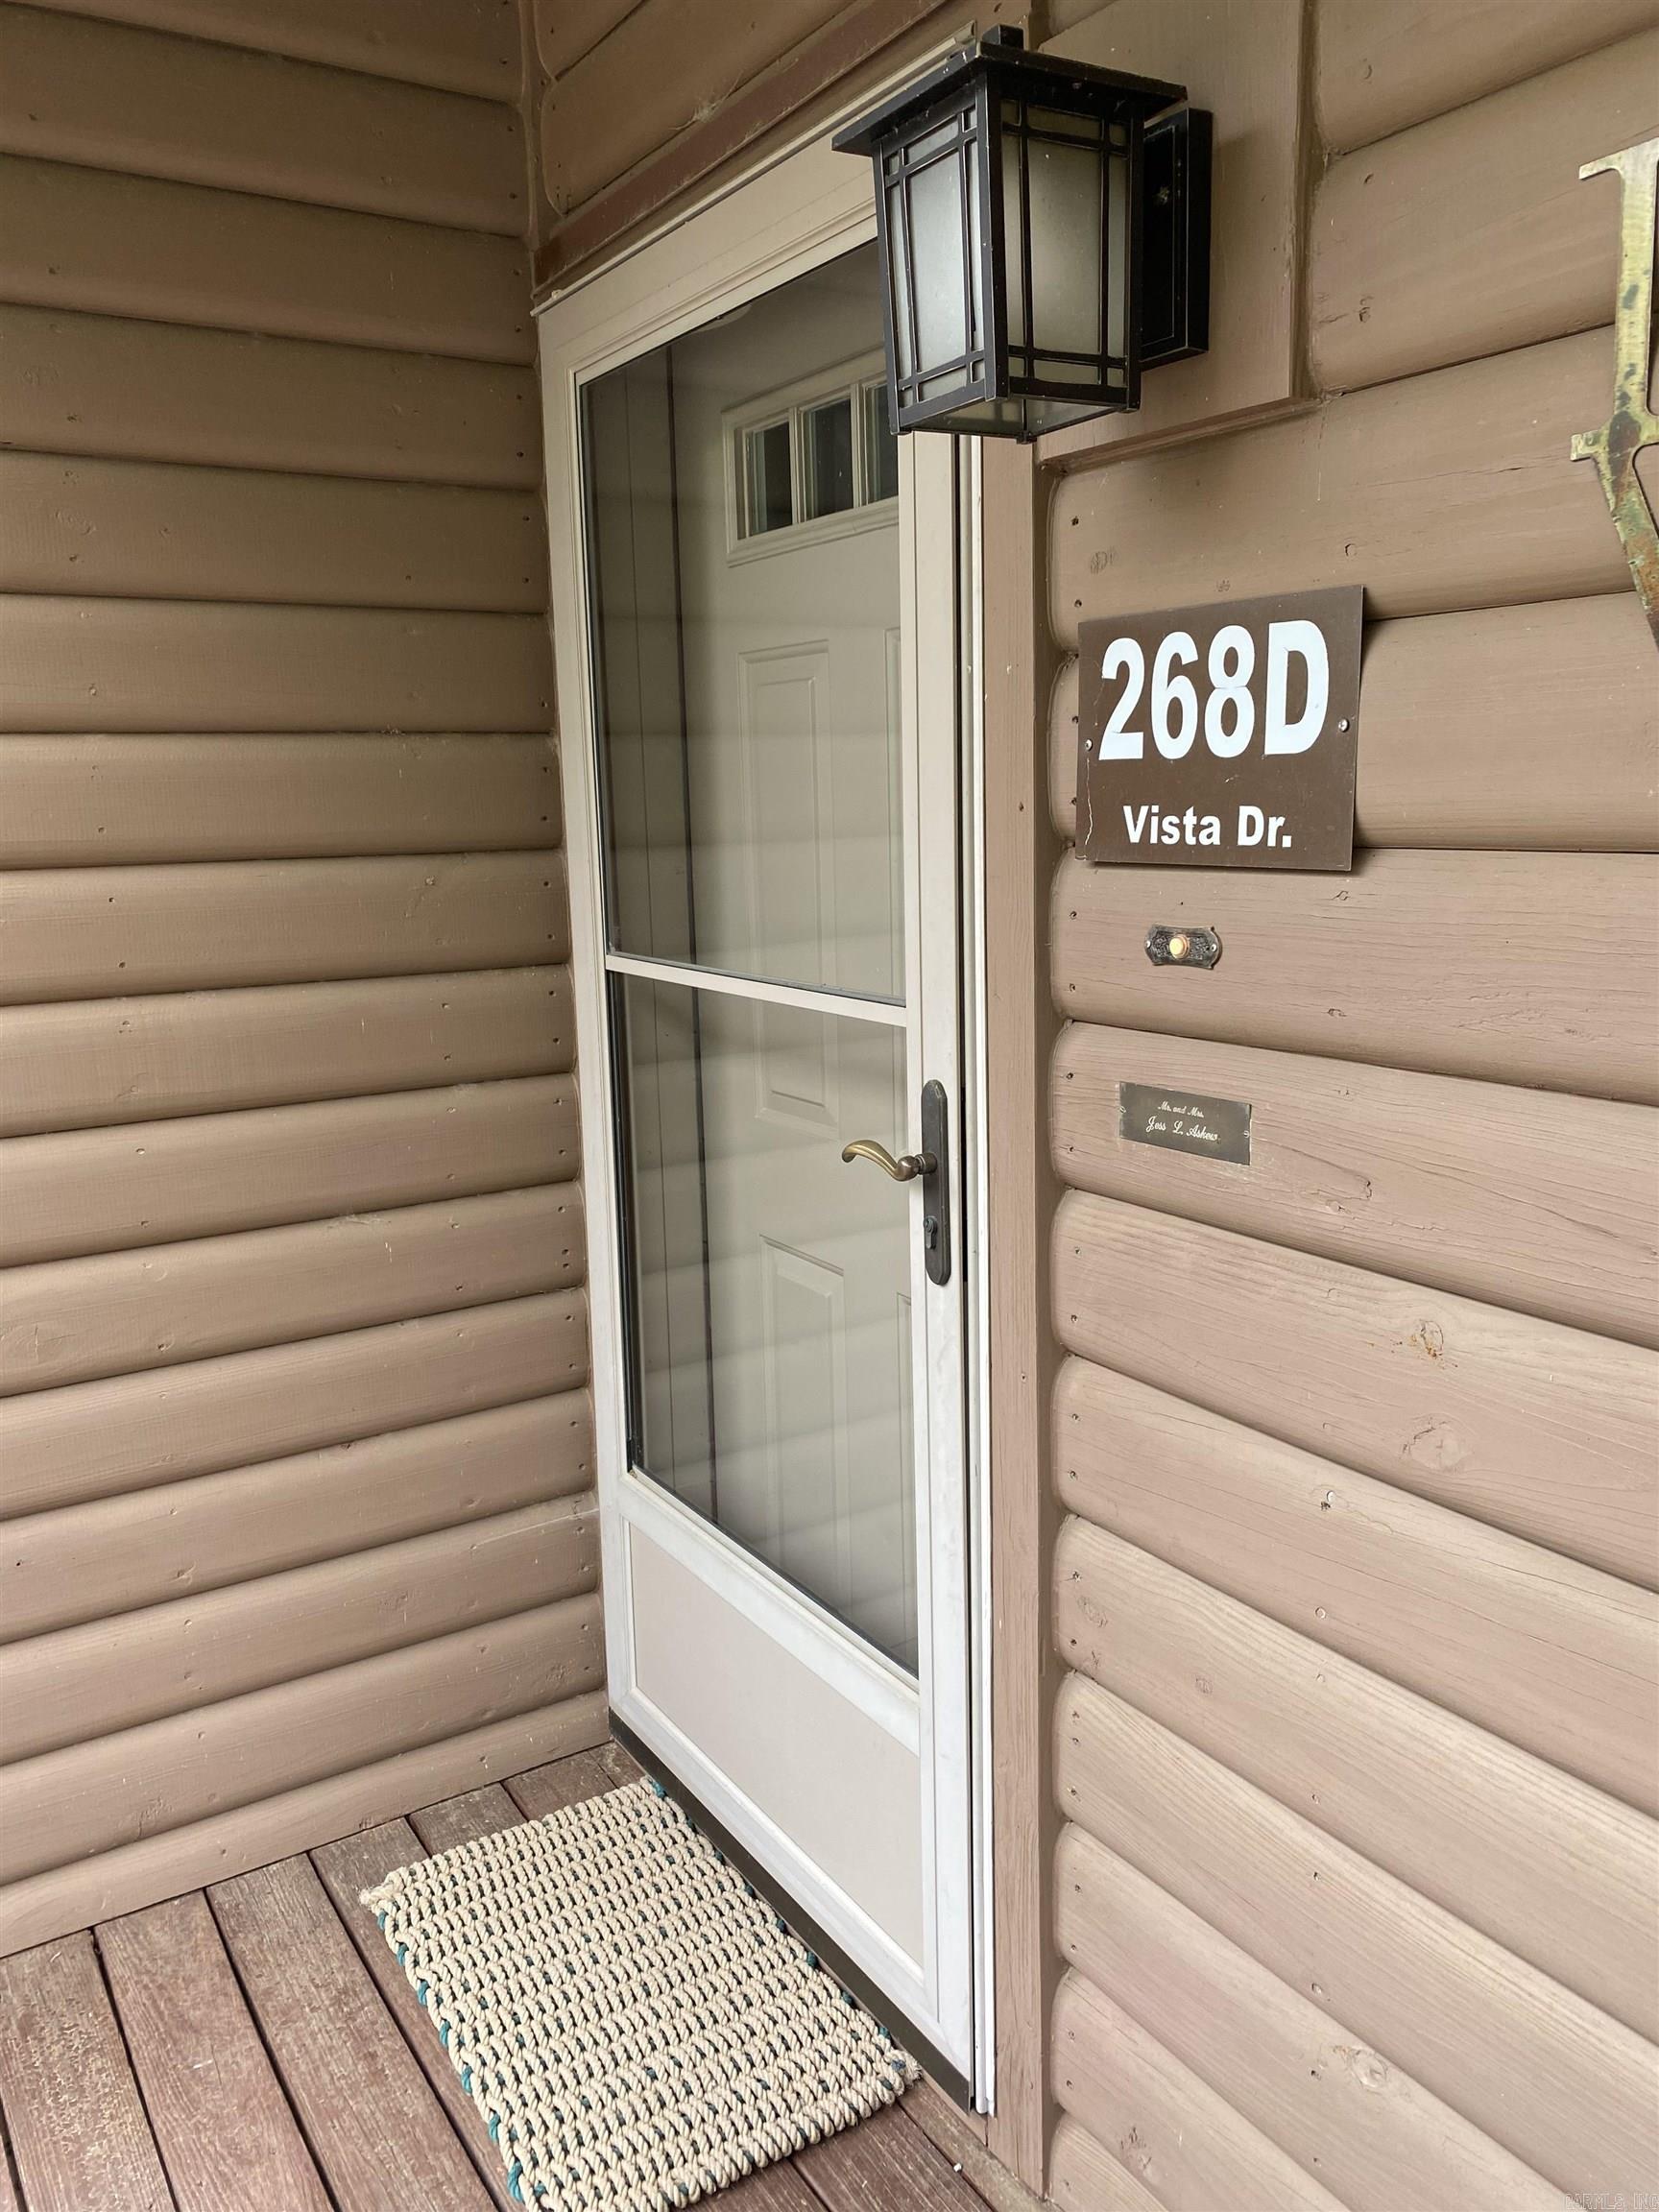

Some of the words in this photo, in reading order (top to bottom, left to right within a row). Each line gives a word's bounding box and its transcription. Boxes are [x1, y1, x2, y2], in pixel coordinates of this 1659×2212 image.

[1098, 619, 1330, 760] 268D
[1122, 805, 1221, 846] Vista
[1237, 805, 1292, 848] Dr.
[1157, 1100, 1172, 1113] Mr.
[1172, 1105, 1187, 1115] and
[1187, 1106, 1205, 1118] Mrs.
[1145, 1116, 1166, 1133] Jess
[1172, 1120, 1184, 1136] L.
